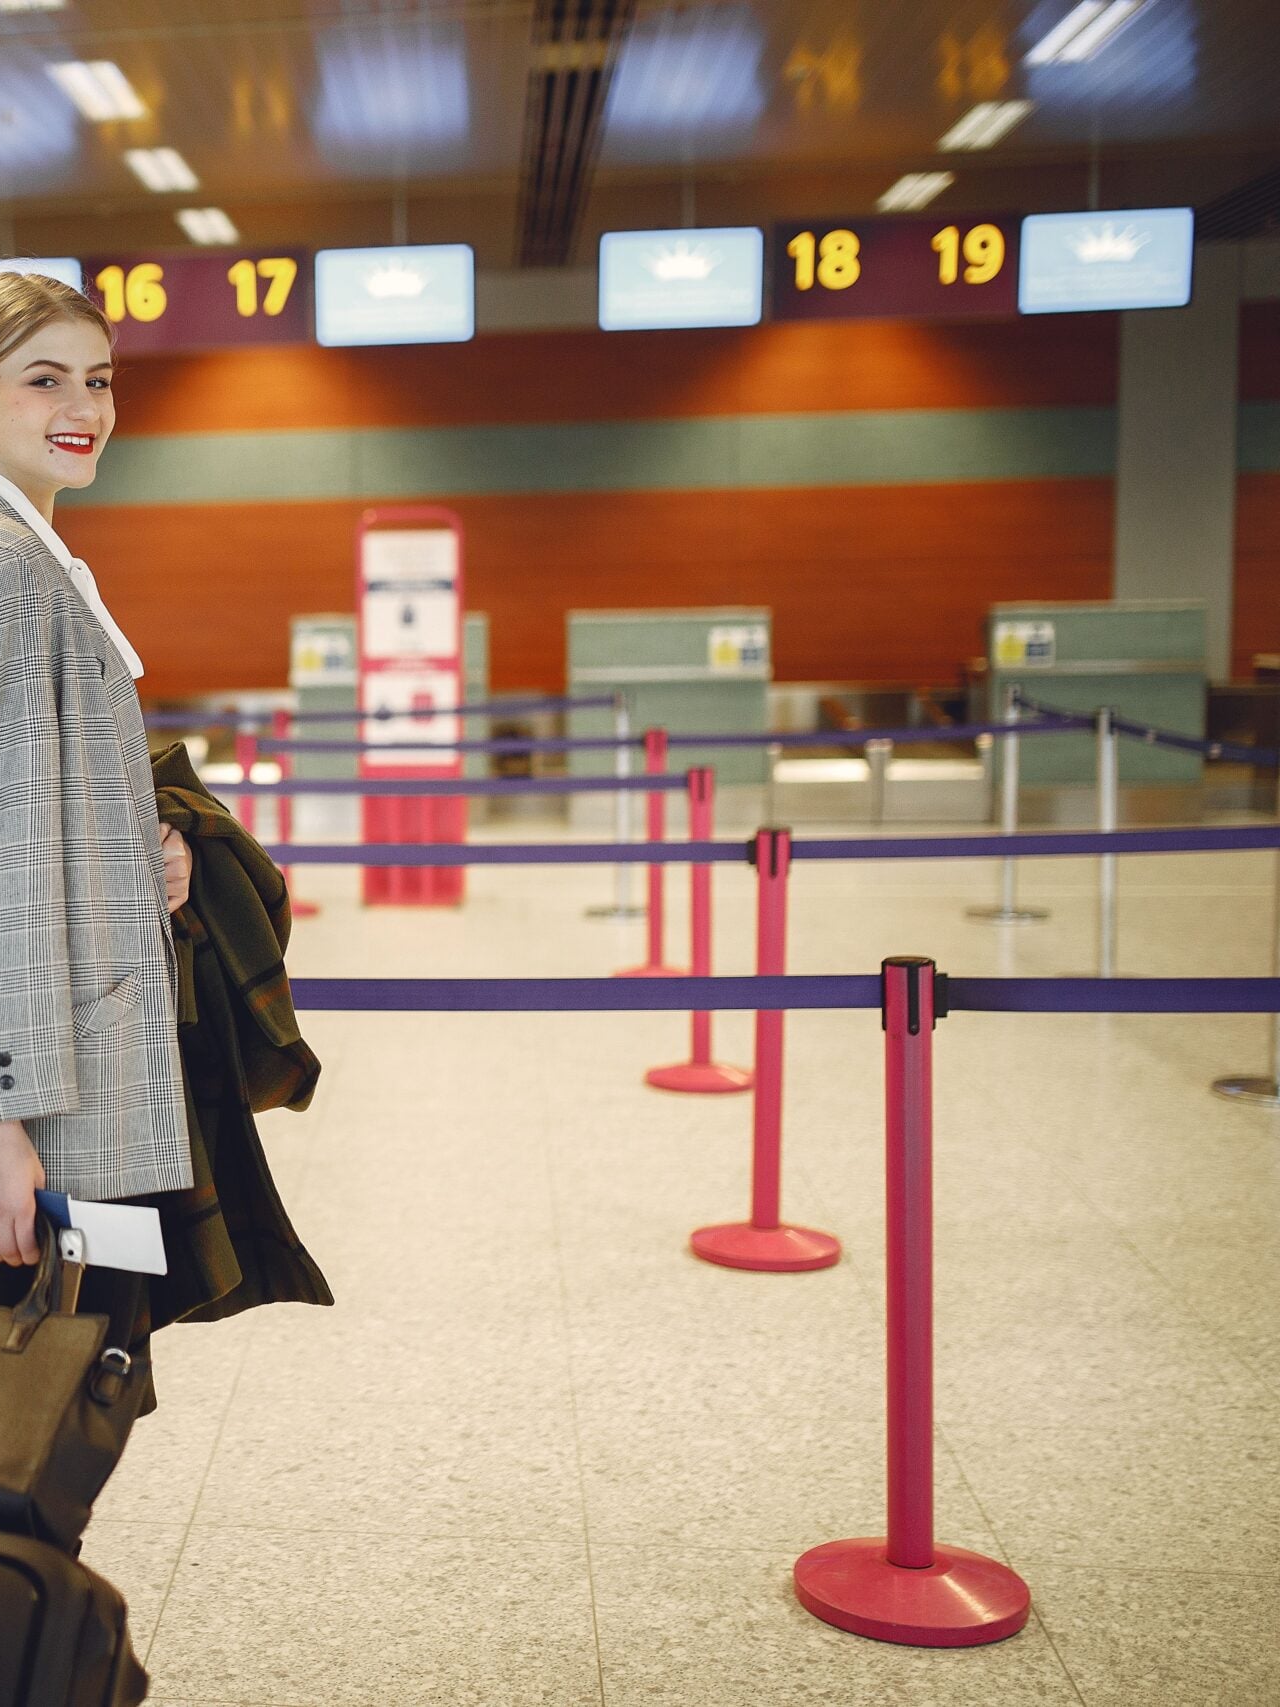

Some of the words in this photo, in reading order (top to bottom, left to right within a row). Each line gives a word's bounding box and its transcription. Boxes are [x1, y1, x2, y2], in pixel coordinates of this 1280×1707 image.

[95, 262, 168, 323] 16
[227, 257, 298, 318] 17
[787, 229, 862, 291] 18
[931, 223, 1006, 286] 19
